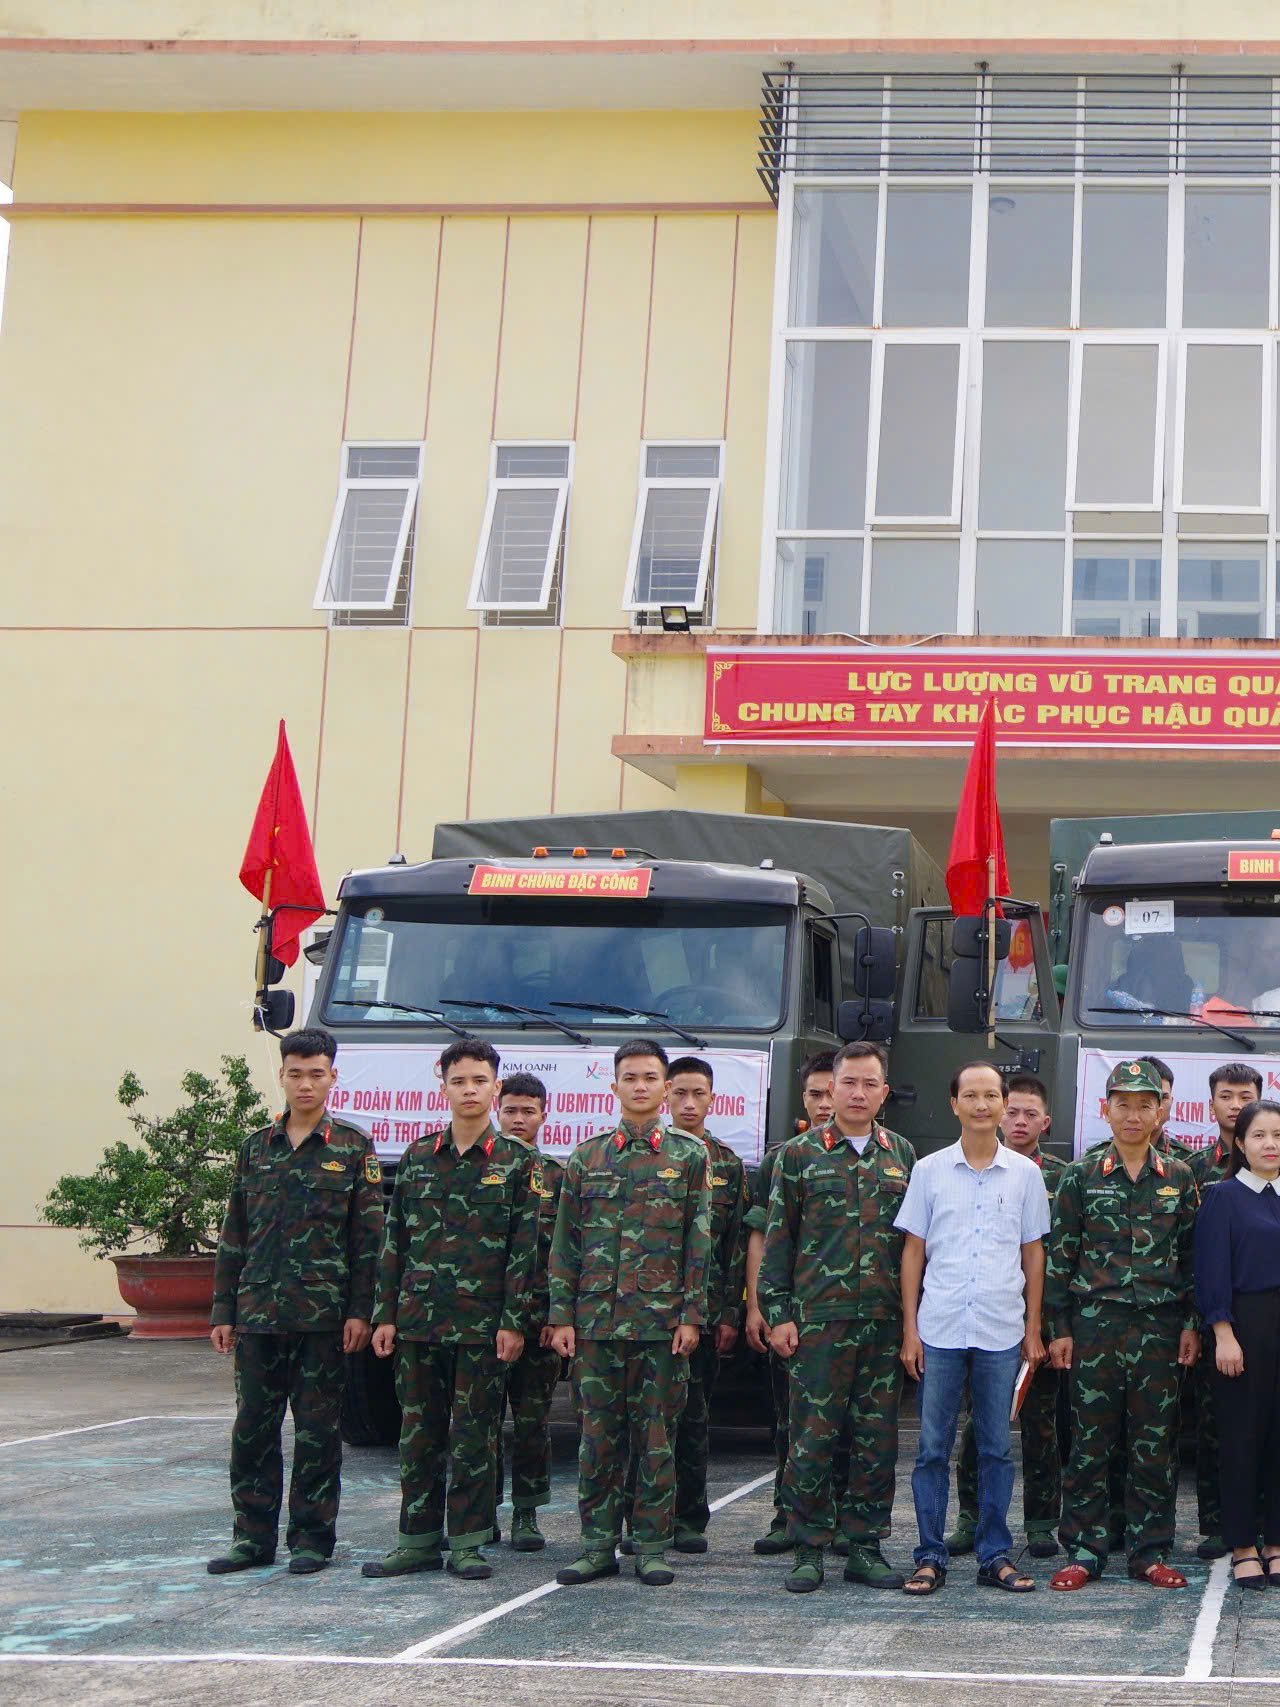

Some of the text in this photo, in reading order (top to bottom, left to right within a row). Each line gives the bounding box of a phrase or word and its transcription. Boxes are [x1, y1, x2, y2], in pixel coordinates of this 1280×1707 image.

[848, 671, 912, 695] LỰC
[924, 671, 1037, 696] LƯỢNG
[1048, 671, 1092, 693] VŨ
[1103, 674, 1217, 695] TRANG
[738, 702, 855, 723] CHUNG
[866, 703, 922, 723] TAY
[1037, 704, 1130, 728] PHỤC
[1141, 703, 1211, 729] HẬU
[1239, 859, 1274, 874] BINH
[481, 873, 516, 888] BINH
[600, 873, 639, 891] CÔNG
[1142, 911, 1160, 924] 07
[502, 1063, 558, 1072] KIM OANH
[353, 1086, 392, 1111] ĐOÀN
[395, 1090, 423, 1111] KIM
[556, 1092, 614, 1116] UBMTTQ
[1175, 1101, 1205, 1123] KIM
[543, 1121, 572, 1146] BÃO
